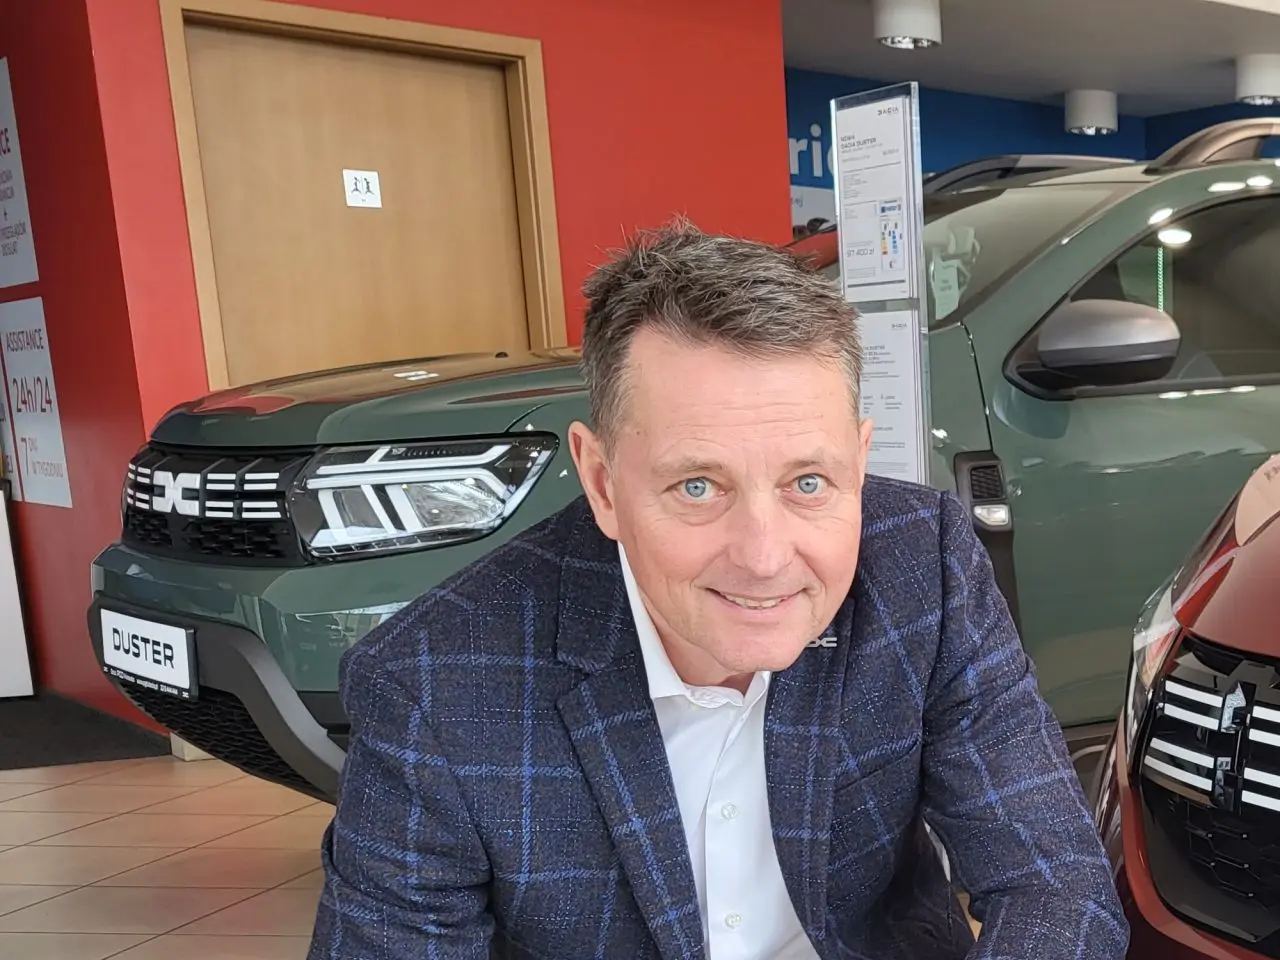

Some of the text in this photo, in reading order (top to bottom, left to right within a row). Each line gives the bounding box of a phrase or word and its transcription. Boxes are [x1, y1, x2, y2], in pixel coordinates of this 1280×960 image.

[788, 123, 836, 178] ri
[6, 328, 44, 352] ASSISTANCE
[13, 376, 53, 413] 24h/24
[112, 627, 175, 669] DUSTER
